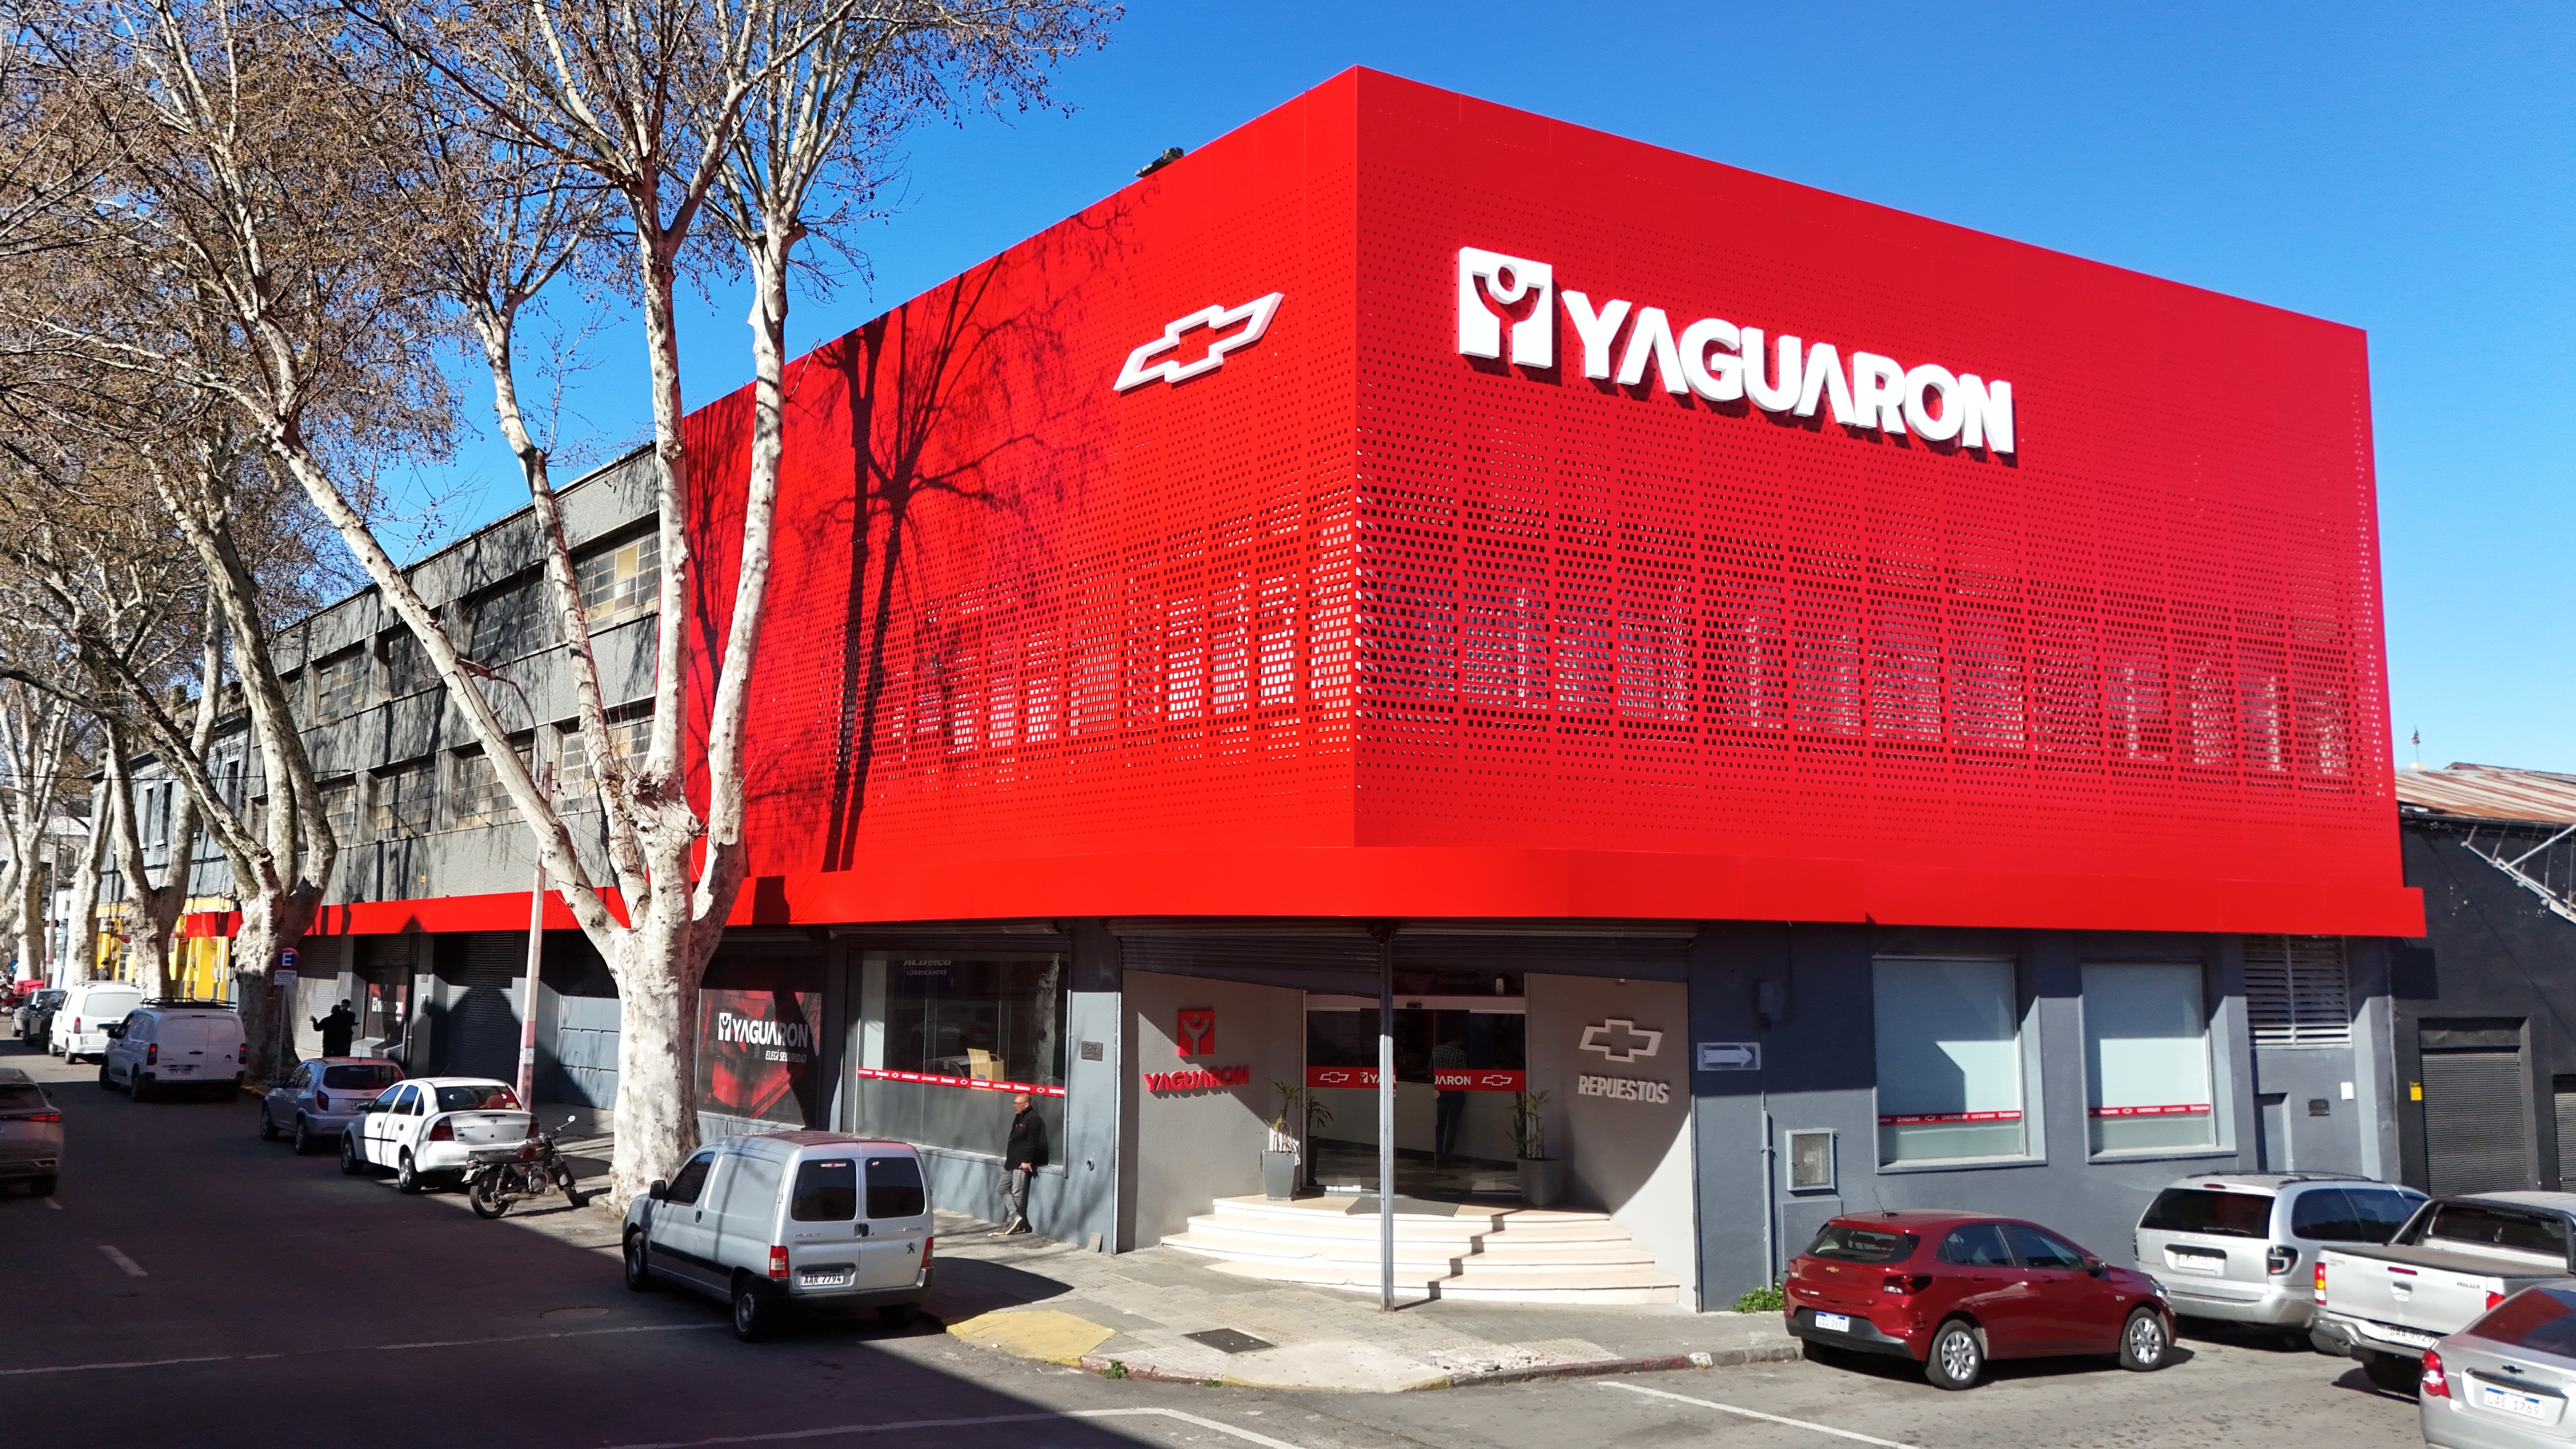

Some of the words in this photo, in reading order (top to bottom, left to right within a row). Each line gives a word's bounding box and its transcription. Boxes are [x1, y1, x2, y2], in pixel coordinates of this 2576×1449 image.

[1562, 290, 2014, 455] YAGUARON
[282, 952, 293, 967] E
[733, 1019, 808, 1048] YAGUARON
[779, 1051, 807, 1063] SEGURIDAD
[1143, 1066, 1249, 1091] YAGUARON
[1578, 1075, 1670, 1104] REPUESTOS
[804, 1276, 819, 1285] AAR
[822, 1274, 842, 1283] 7794
[2456, 1281, 2481, 1289] HILUX
[1831, 1320, 1846, 1330] 2693
[2410, 1329, 2434, 1342] 9929
[2487, 1395, 2506, 1407] LAE
[2514, 1401, 2540, 1415] 1769
